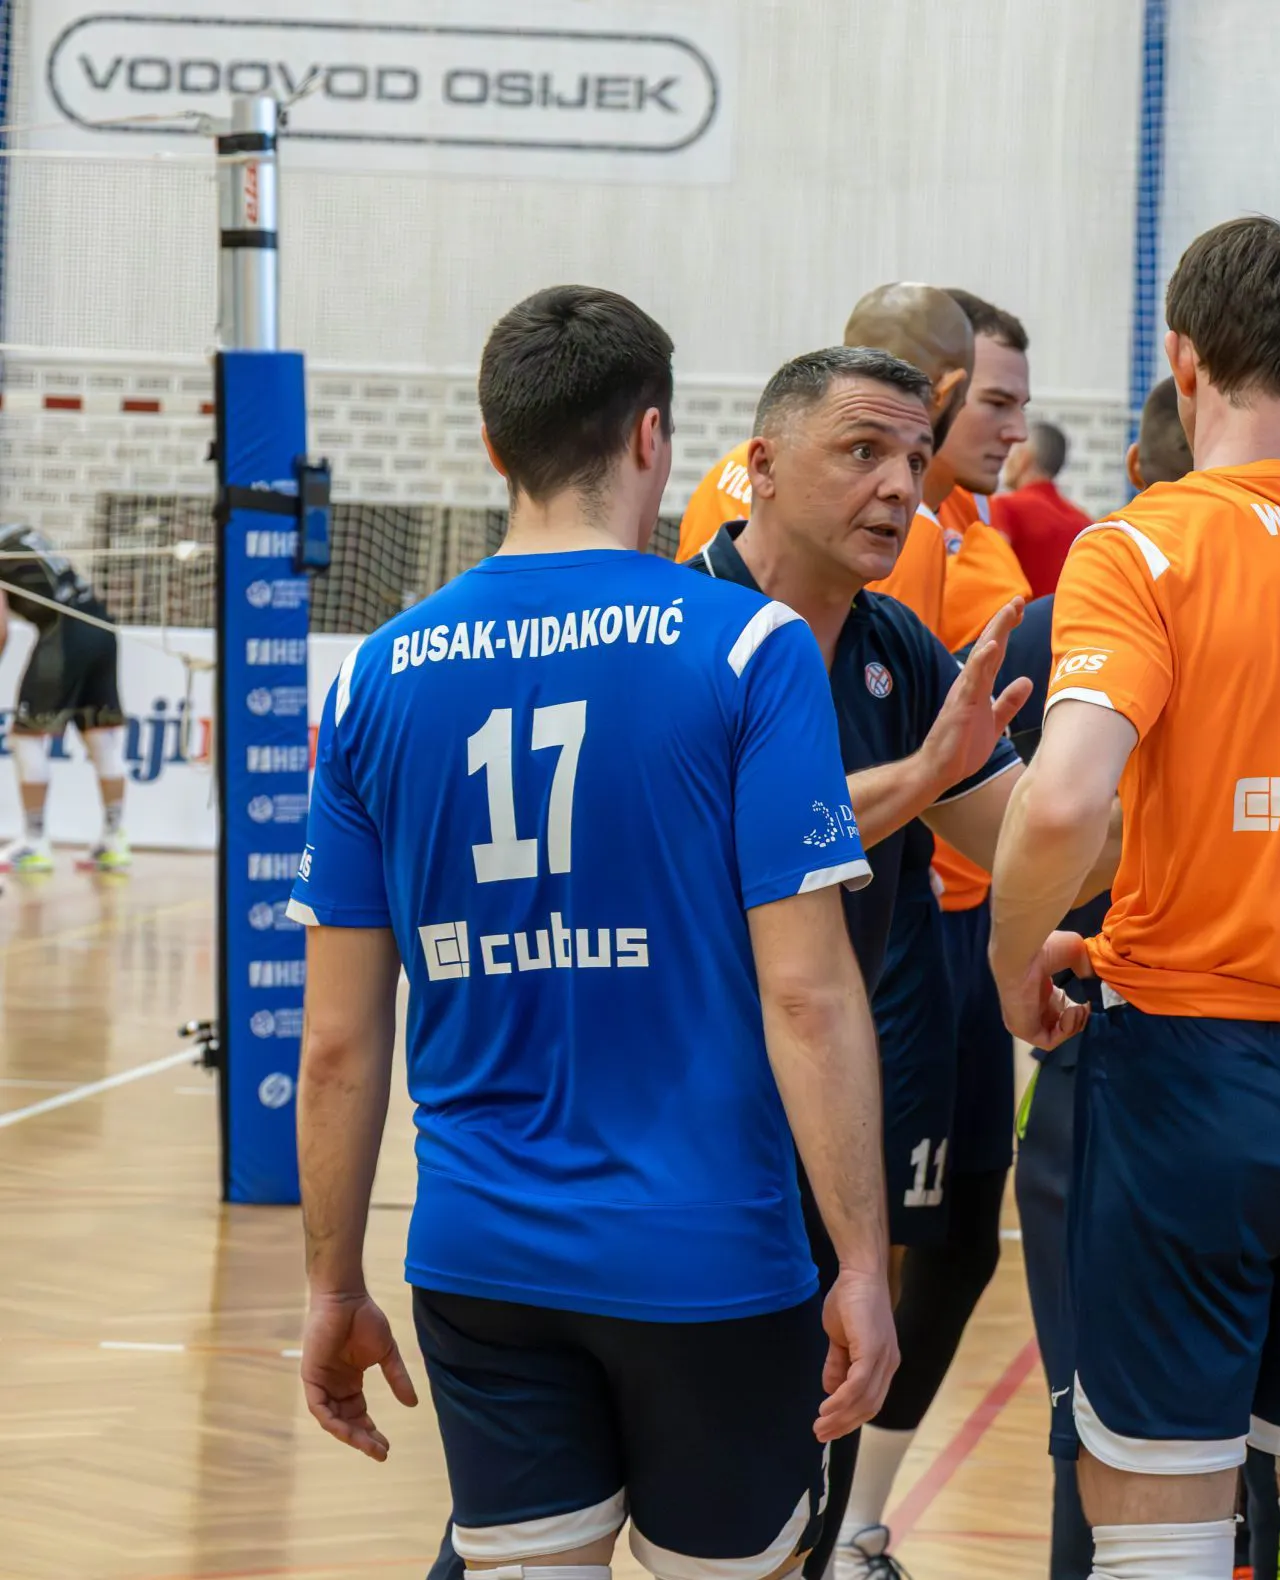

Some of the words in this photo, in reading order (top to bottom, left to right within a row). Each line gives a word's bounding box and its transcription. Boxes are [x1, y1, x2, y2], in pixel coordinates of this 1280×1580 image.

[78, 54, 418, 101] VODOVOD
[444, 68, 680, 114] OSIJEK
[391, 598, 683, 674] BUSAK-VIDAKOVIĆ
[467, 700, 587, 883] 17
[480, 912, 649, 975] cubus
[903, 1138, 948, 1207] 11
